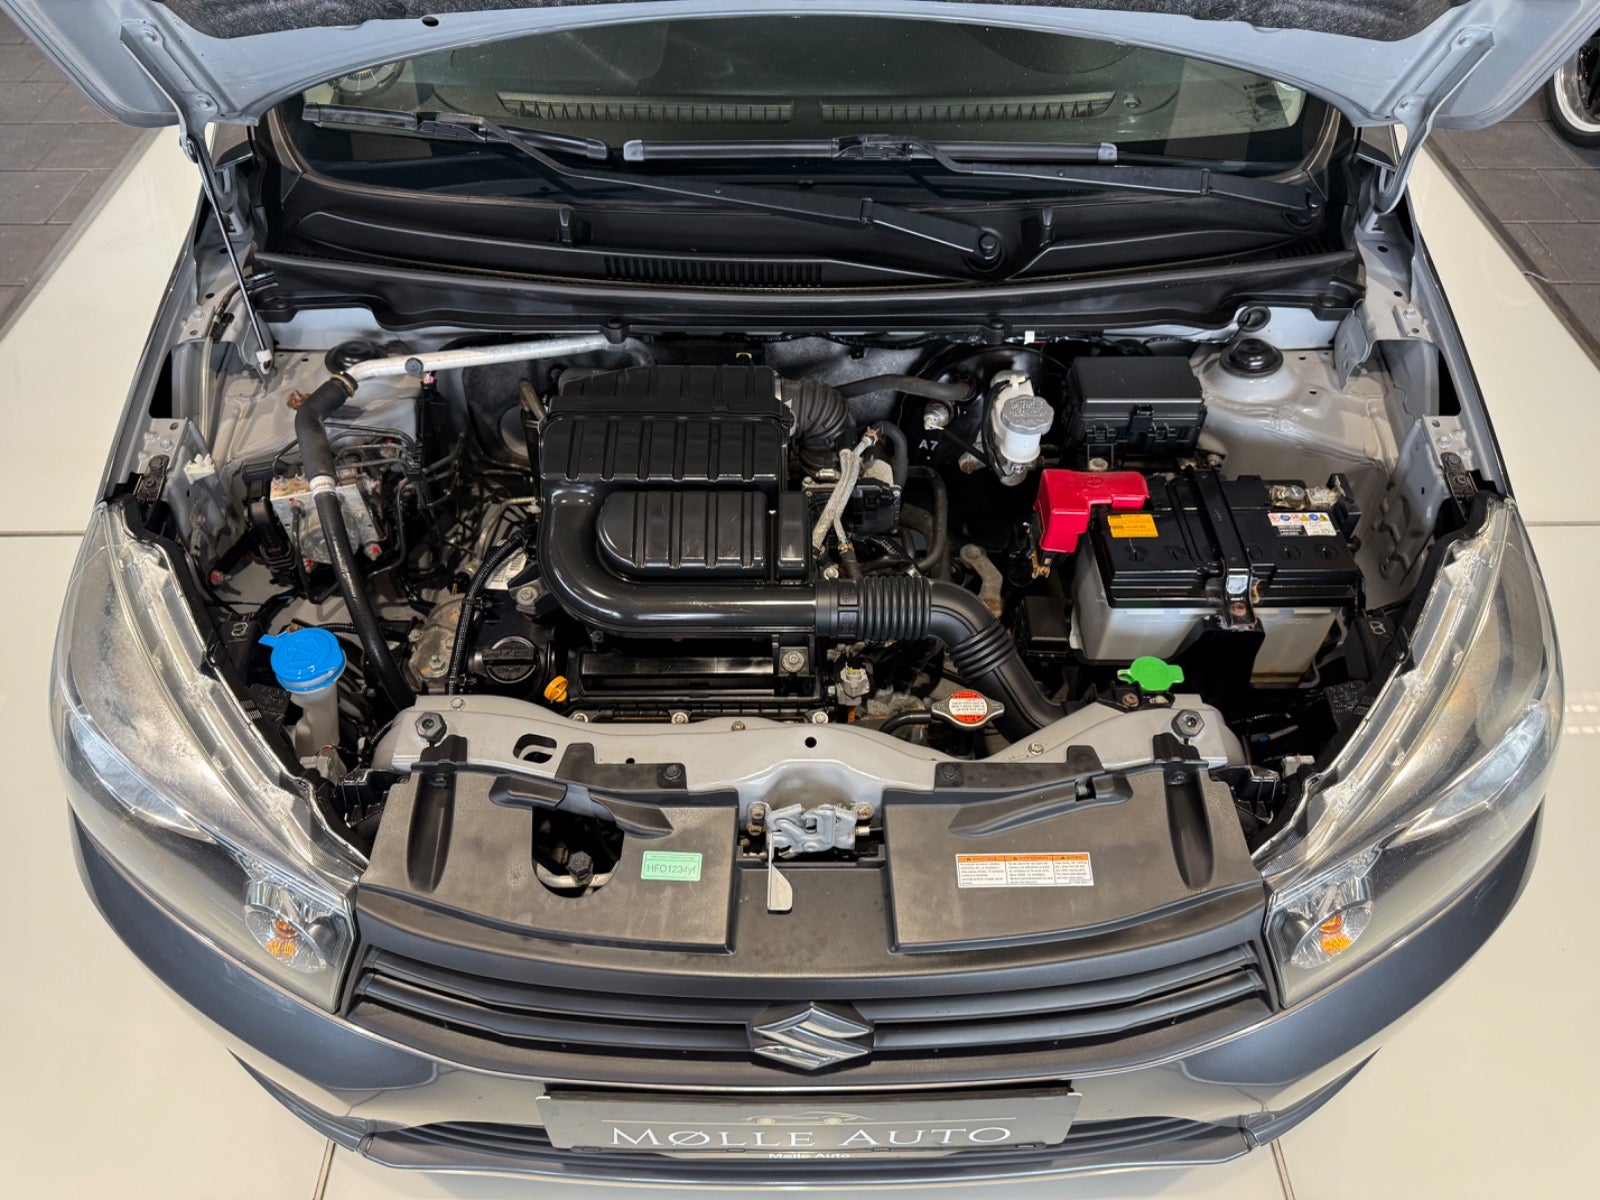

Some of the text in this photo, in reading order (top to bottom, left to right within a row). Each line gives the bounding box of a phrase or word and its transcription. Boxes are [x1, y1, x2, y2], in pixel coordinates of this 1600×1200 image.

[918, 439, 939, 450] A7
[610, 1126, 1012, 1147] MØLLE AUTO
